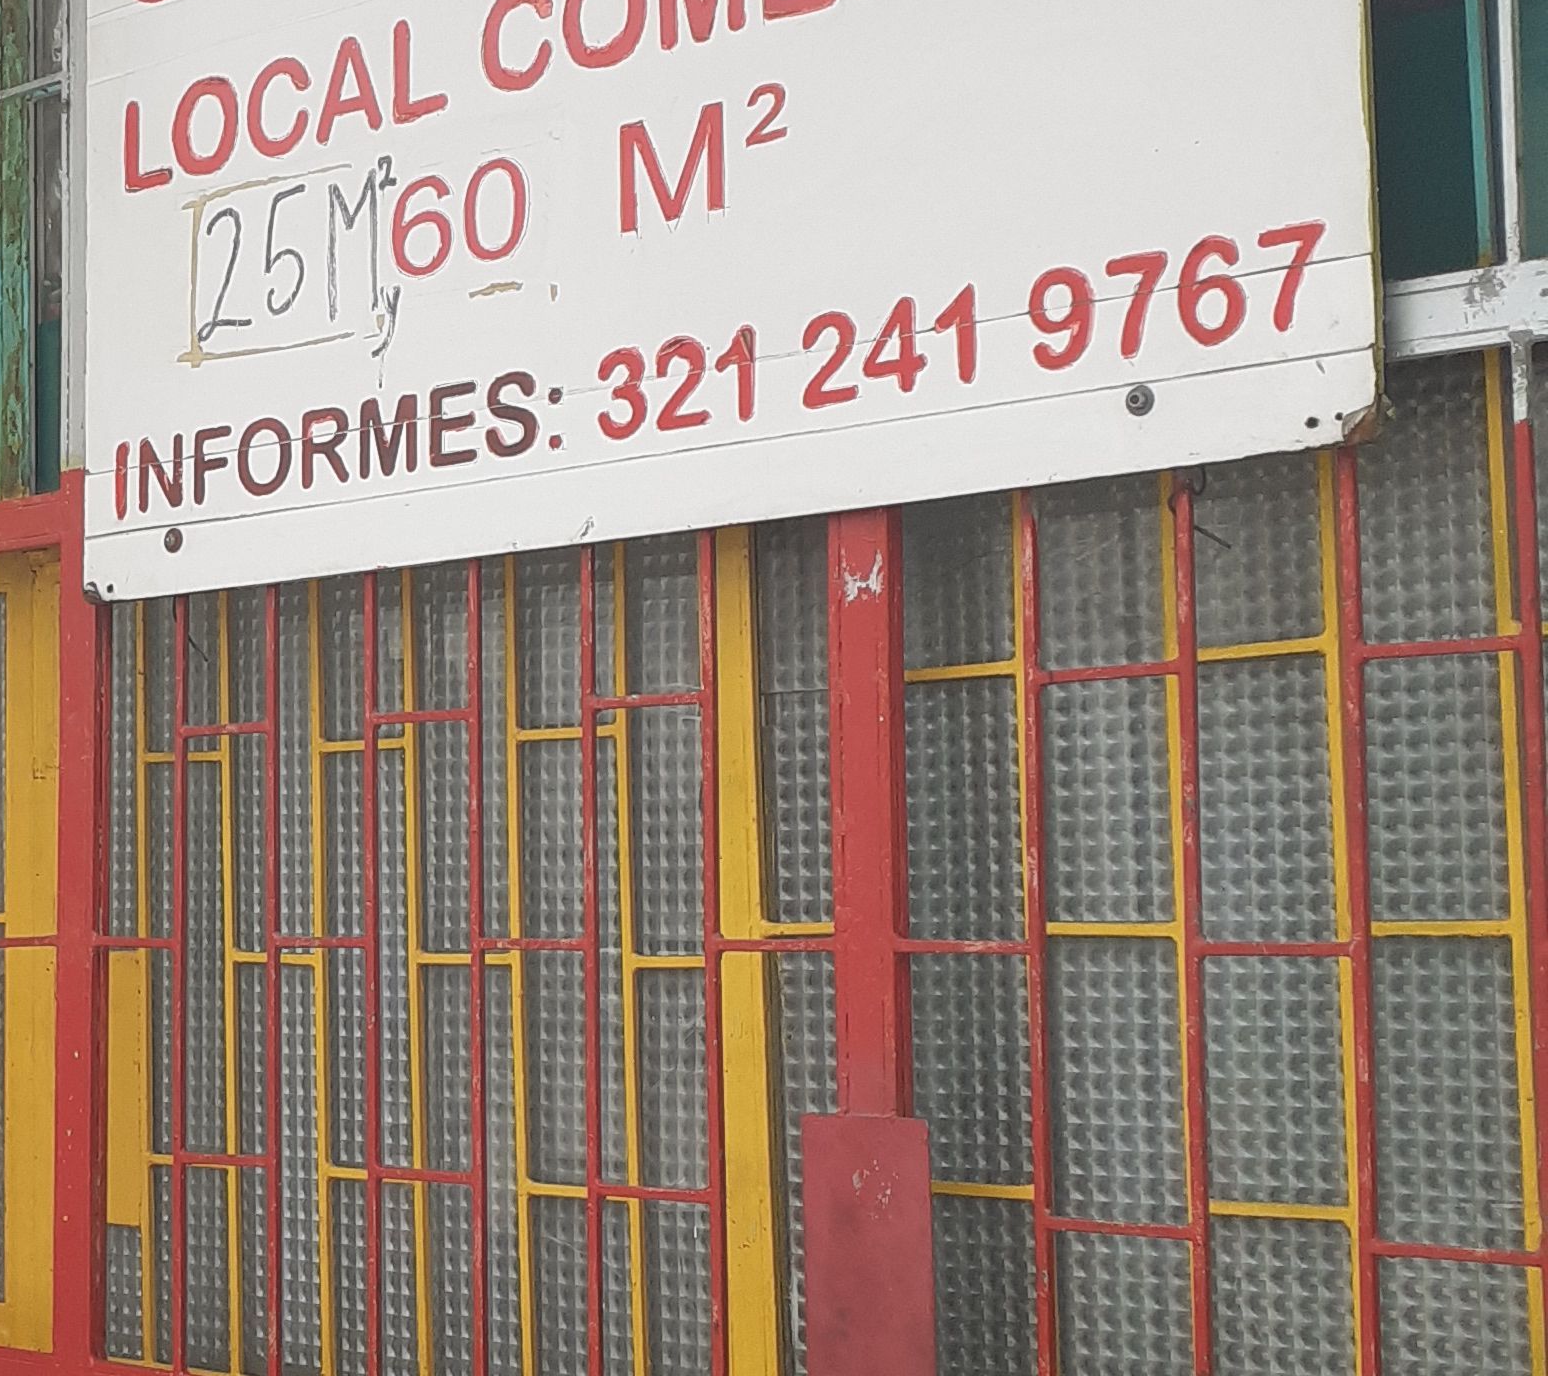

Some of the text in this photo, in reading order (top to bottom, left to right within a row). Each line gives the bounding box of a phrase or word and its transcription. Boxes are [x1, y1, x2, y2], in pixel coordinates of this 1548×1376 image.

[124, 18, 448, 193] LOCAL
[390, 157, 527, 278] 60
[114, 220, 1328, 522] INFORMES: 321 241 9767
